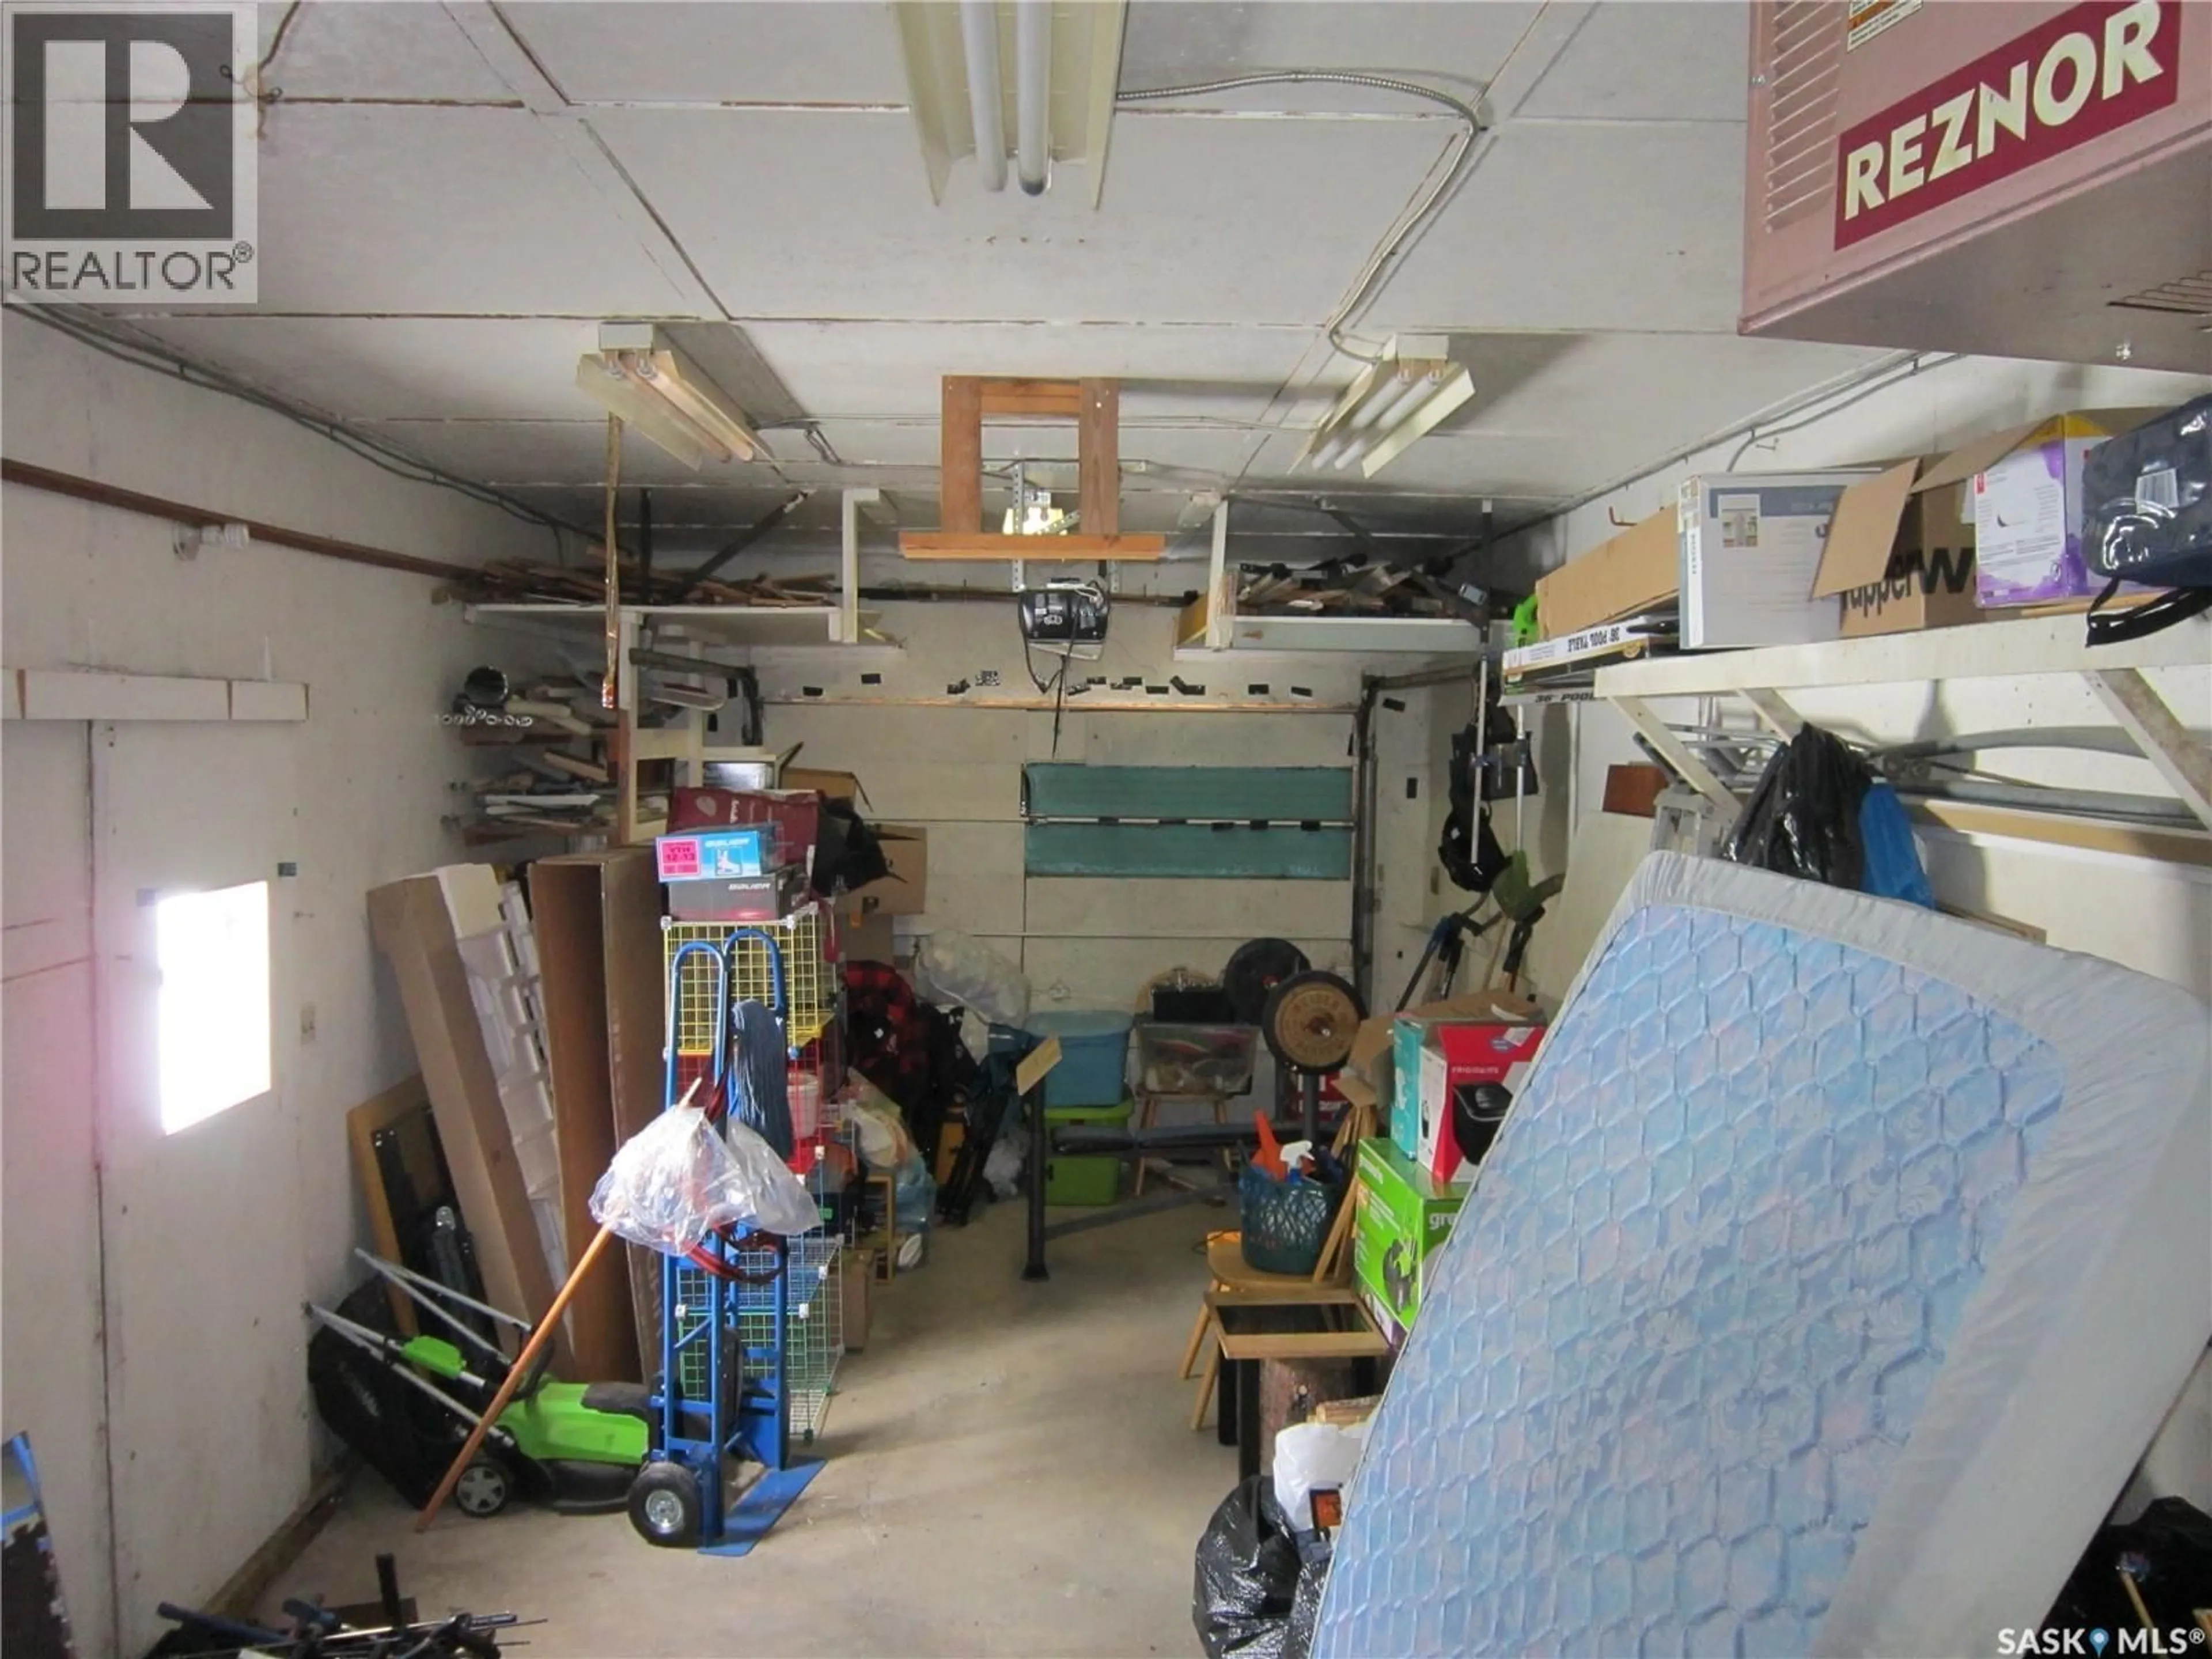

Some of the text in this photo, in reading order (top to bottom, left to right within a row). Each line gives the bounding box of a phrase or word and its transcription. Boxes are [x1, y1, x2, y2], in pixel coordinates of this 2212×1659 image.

[1844, 0, 2165, 221] REZNOR
[1567, 635, 1589, 653] TABLE
[1590, 630, 1608, 647] POOL
